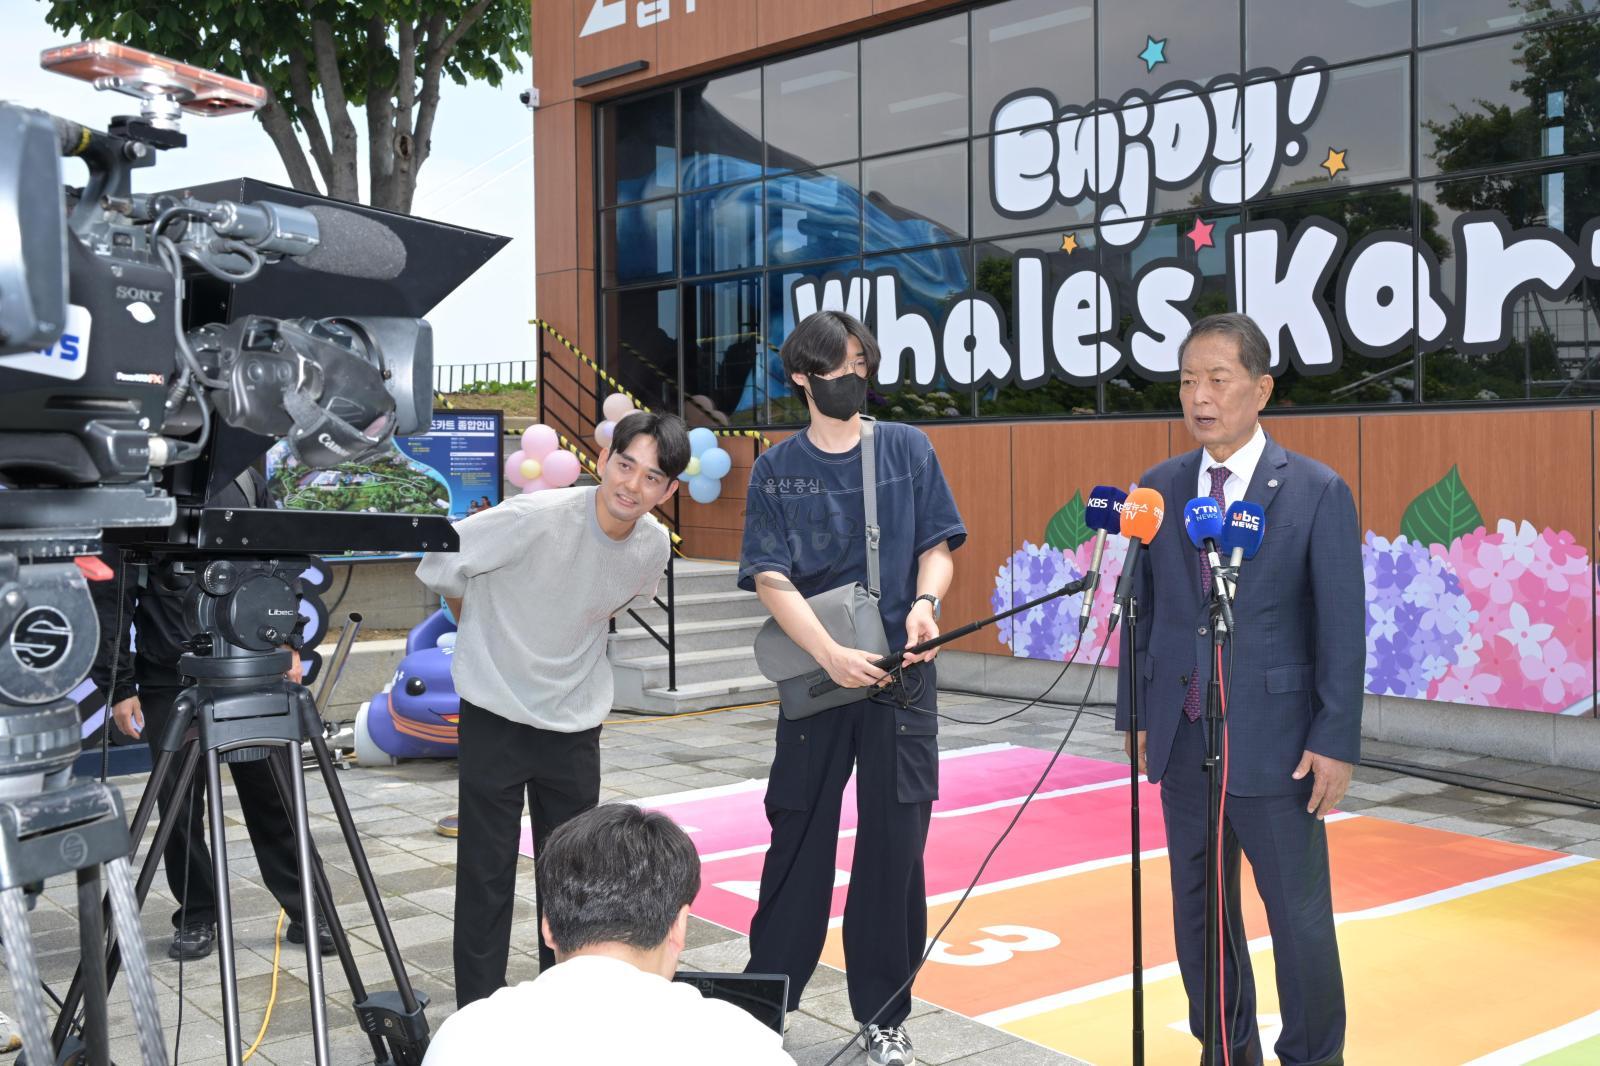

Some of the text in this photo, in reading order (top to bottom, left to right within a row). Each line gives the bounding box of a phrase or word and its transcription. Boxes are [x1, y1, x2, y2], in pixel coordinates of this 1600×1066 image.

[992, 62, 1324, 248] Enjoy!
[115, 285, 163, 303] SONY
[1232, 220, 1600, 373] Kar
[430, 419, 456, 430] 즈카트
[1087, 497, 1109, 509] KBS
[1125, 510, 1138, 520] TV
[1191, 505, 1218, 515] YTN
[1195, 513, 1218, 522] NEWS
[1232, 510, 1261, 526] ubc
[1231, 520, 1260, 532] NEWS
[268, 608, 294, 616] Libec
